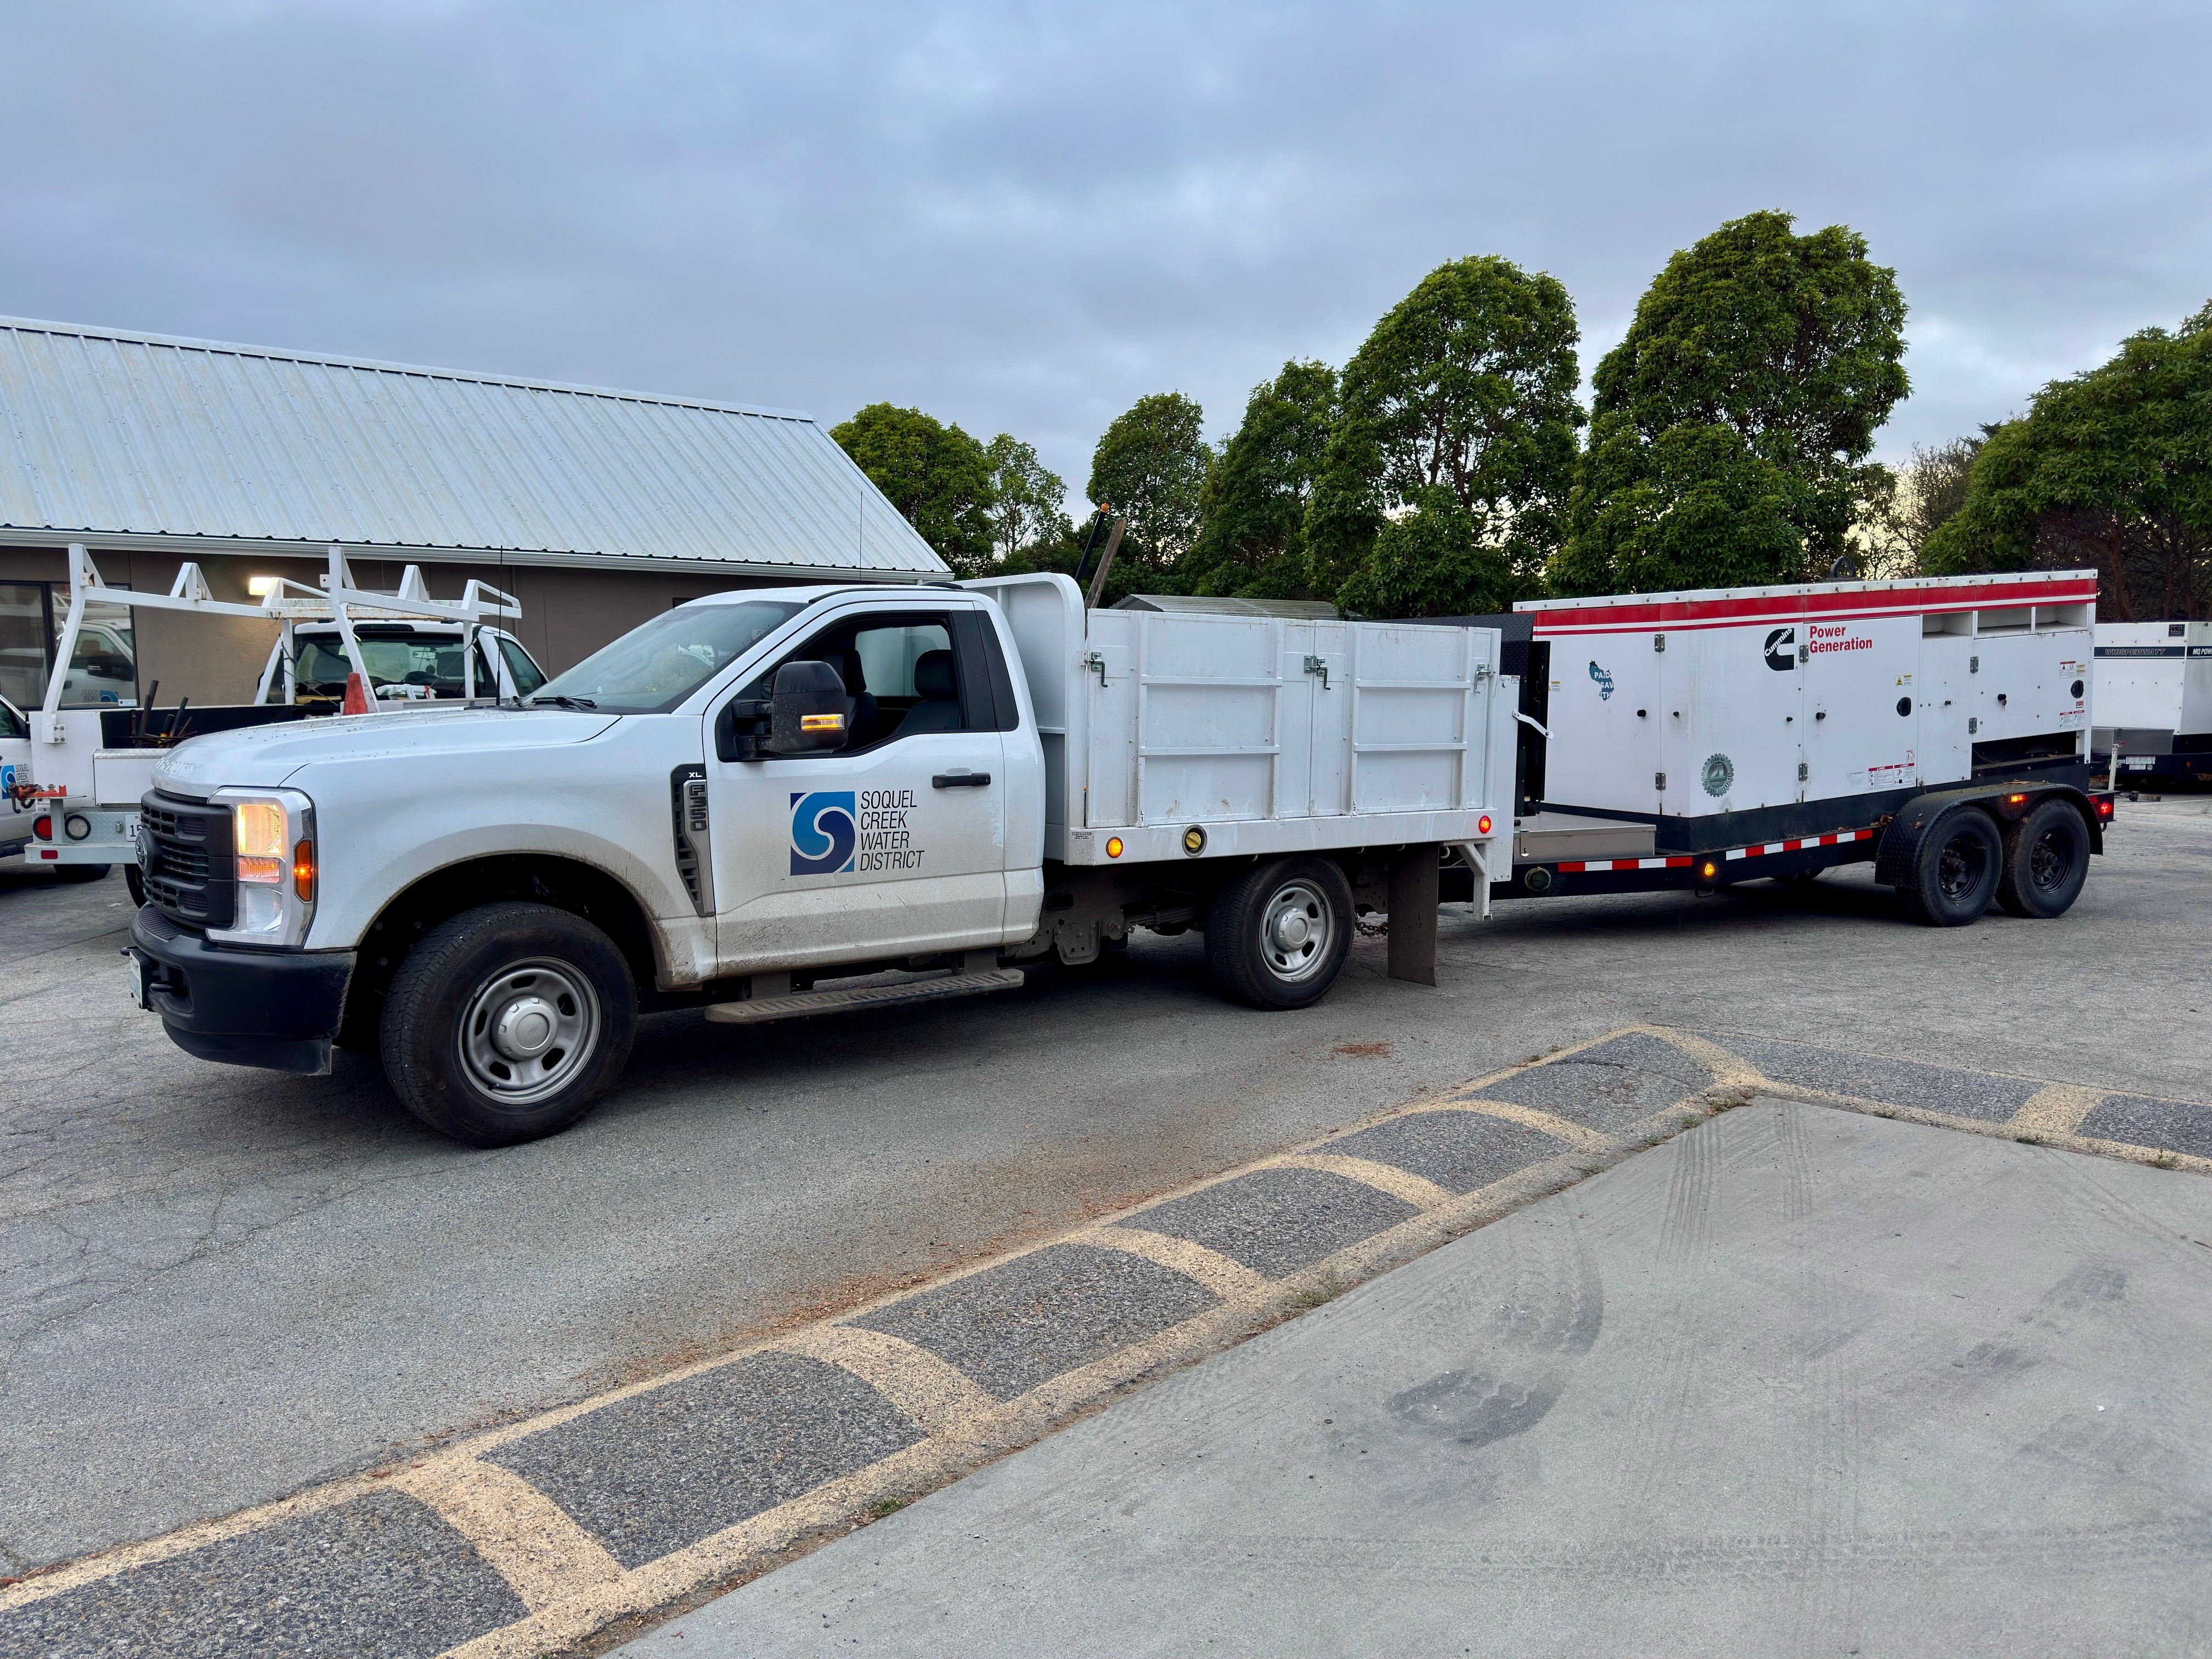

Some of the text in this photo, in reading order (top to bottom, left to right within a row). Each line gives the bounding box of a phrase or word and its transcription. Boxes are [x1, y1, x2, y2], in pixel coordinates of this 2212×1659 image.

[1810, 625, 1846, 639] Power
[1764, 628, 1792, 657] Cummins
[1810, 637, 1872, 653] Generation
[861, 790, 917, 809] SOQUEL
[861, 810, 908, 830] CREEK
[861, 831, 910, 850] WATER
[860, 850, 925, 871] DISTRICT
